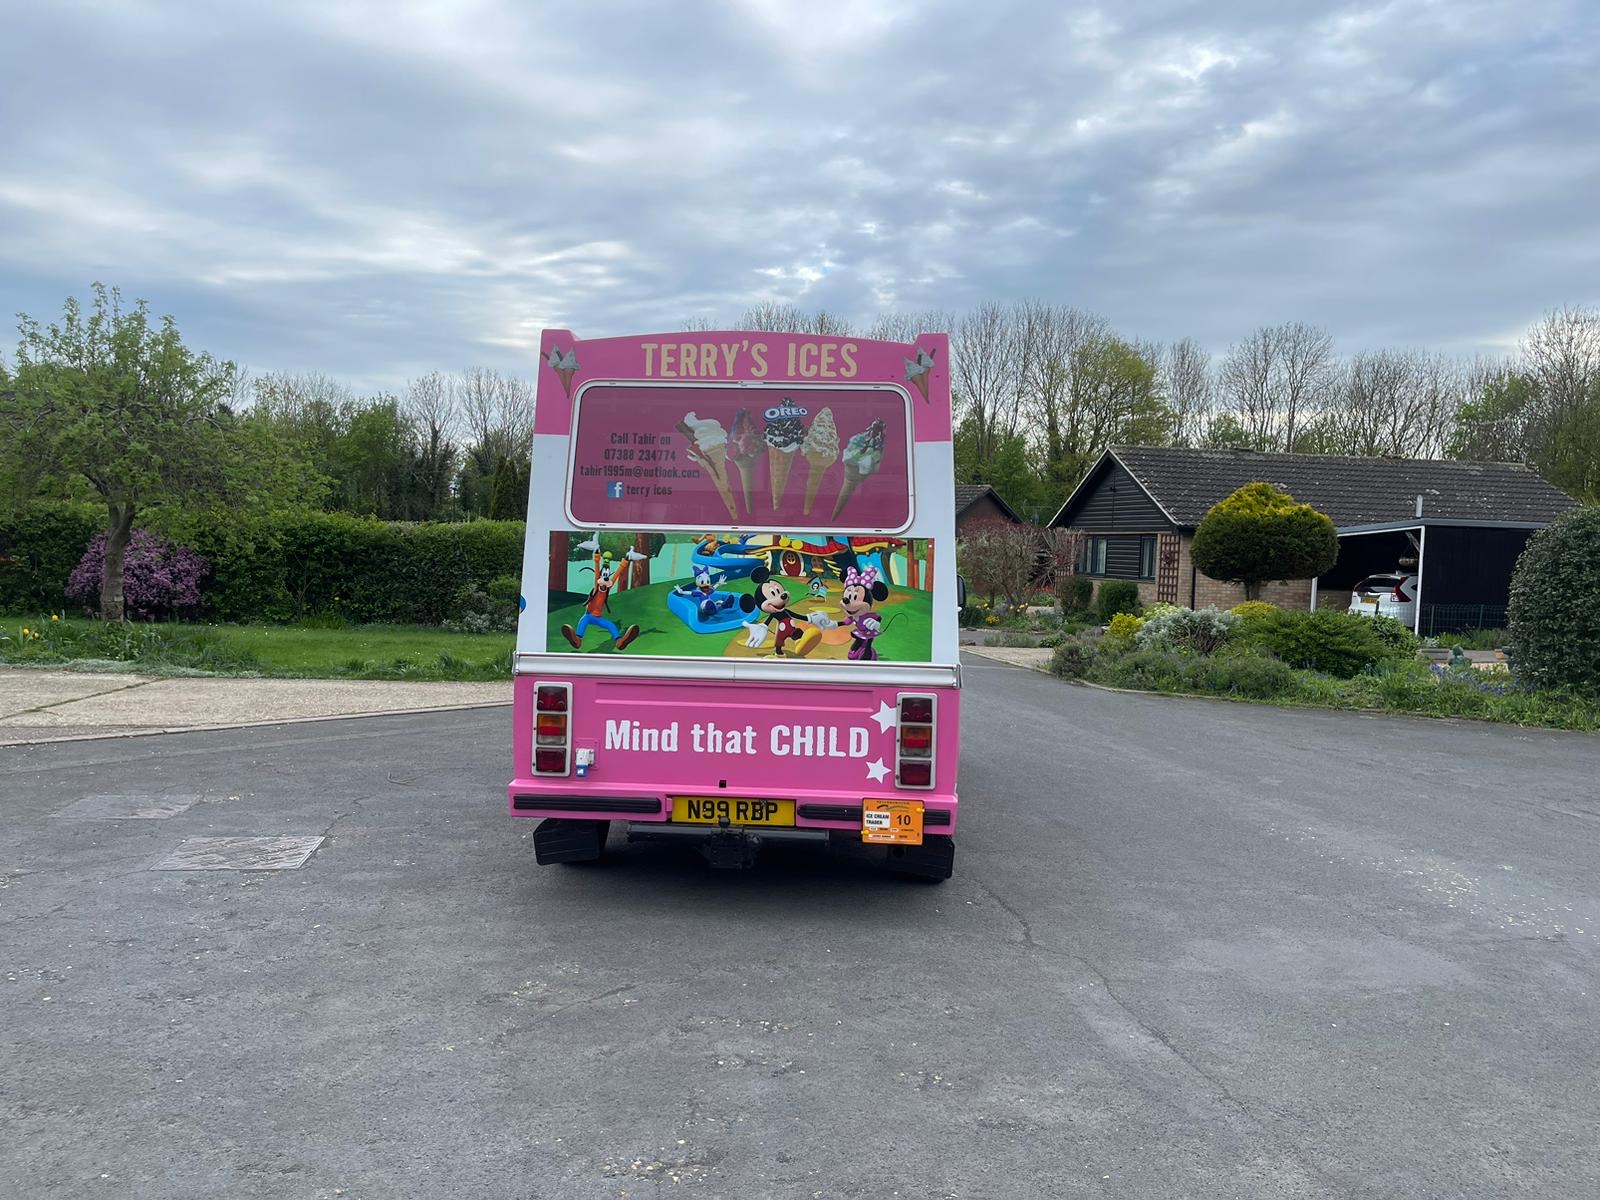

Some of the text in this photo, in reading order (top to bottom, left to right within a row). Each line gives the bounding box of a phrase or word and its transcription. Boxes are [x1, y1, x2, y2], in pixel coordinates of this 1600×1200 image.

[641, 340, 858, 377] TERRY'S ICES
[764, 408, 808, 419] OREO
[611, 433, 628, 444] Call
[660, 436, 671, 445] on
[638, 450, 676, 461] 234774
[626, 485, 650, 496] terry
[654, 485, 672, 495] ices
[605, 720, 869, 757] Mind that CHILD
[688, 800, 778, 821] N99 RBP
[897, 815, 911, 825] 10
